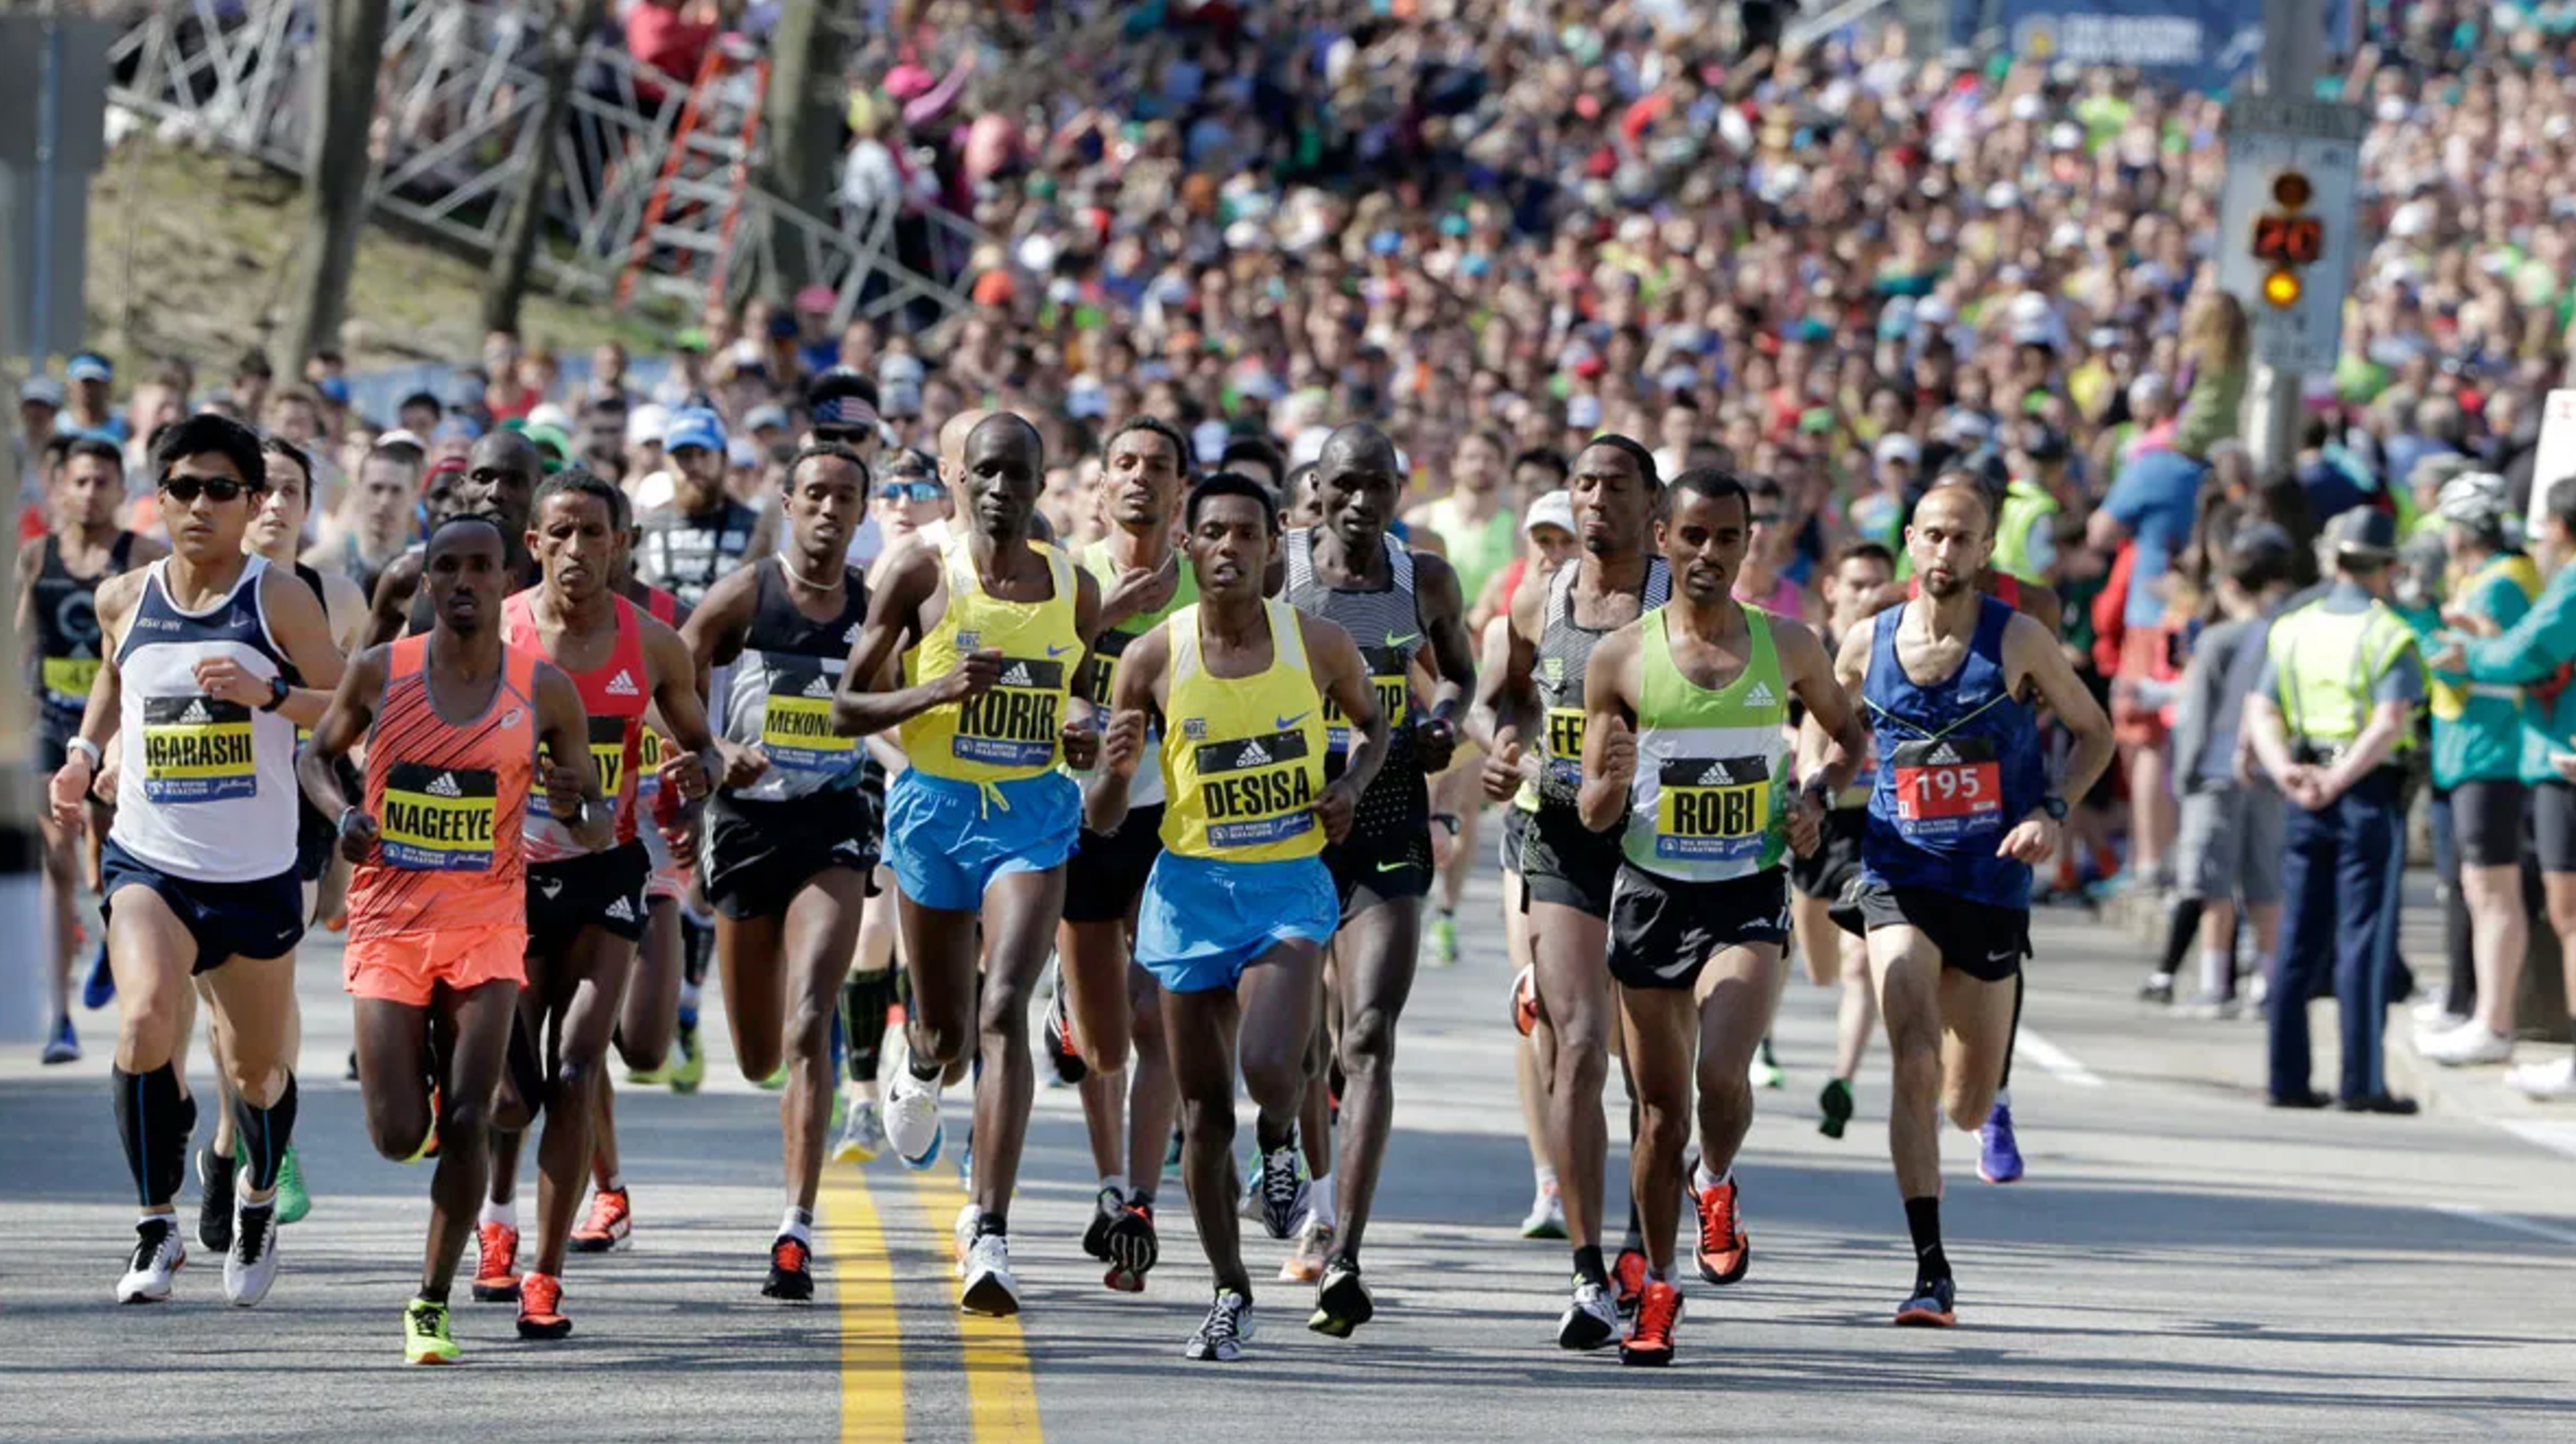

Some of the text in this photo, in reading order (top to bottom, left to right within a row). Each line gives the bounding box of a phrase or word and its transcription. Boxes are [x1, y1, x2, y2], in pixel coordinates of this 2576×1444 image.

[959, 689, 1058, 741] KORIR
[146, 733, 253, 767] IGARASHI
[1203, 766, 1311, 819] DESISA
[1916, 768, 1981, 802] 195
[386, 802, 493, 841] NAGEEYE
[1673, 788, 1755, 835] ROBI
